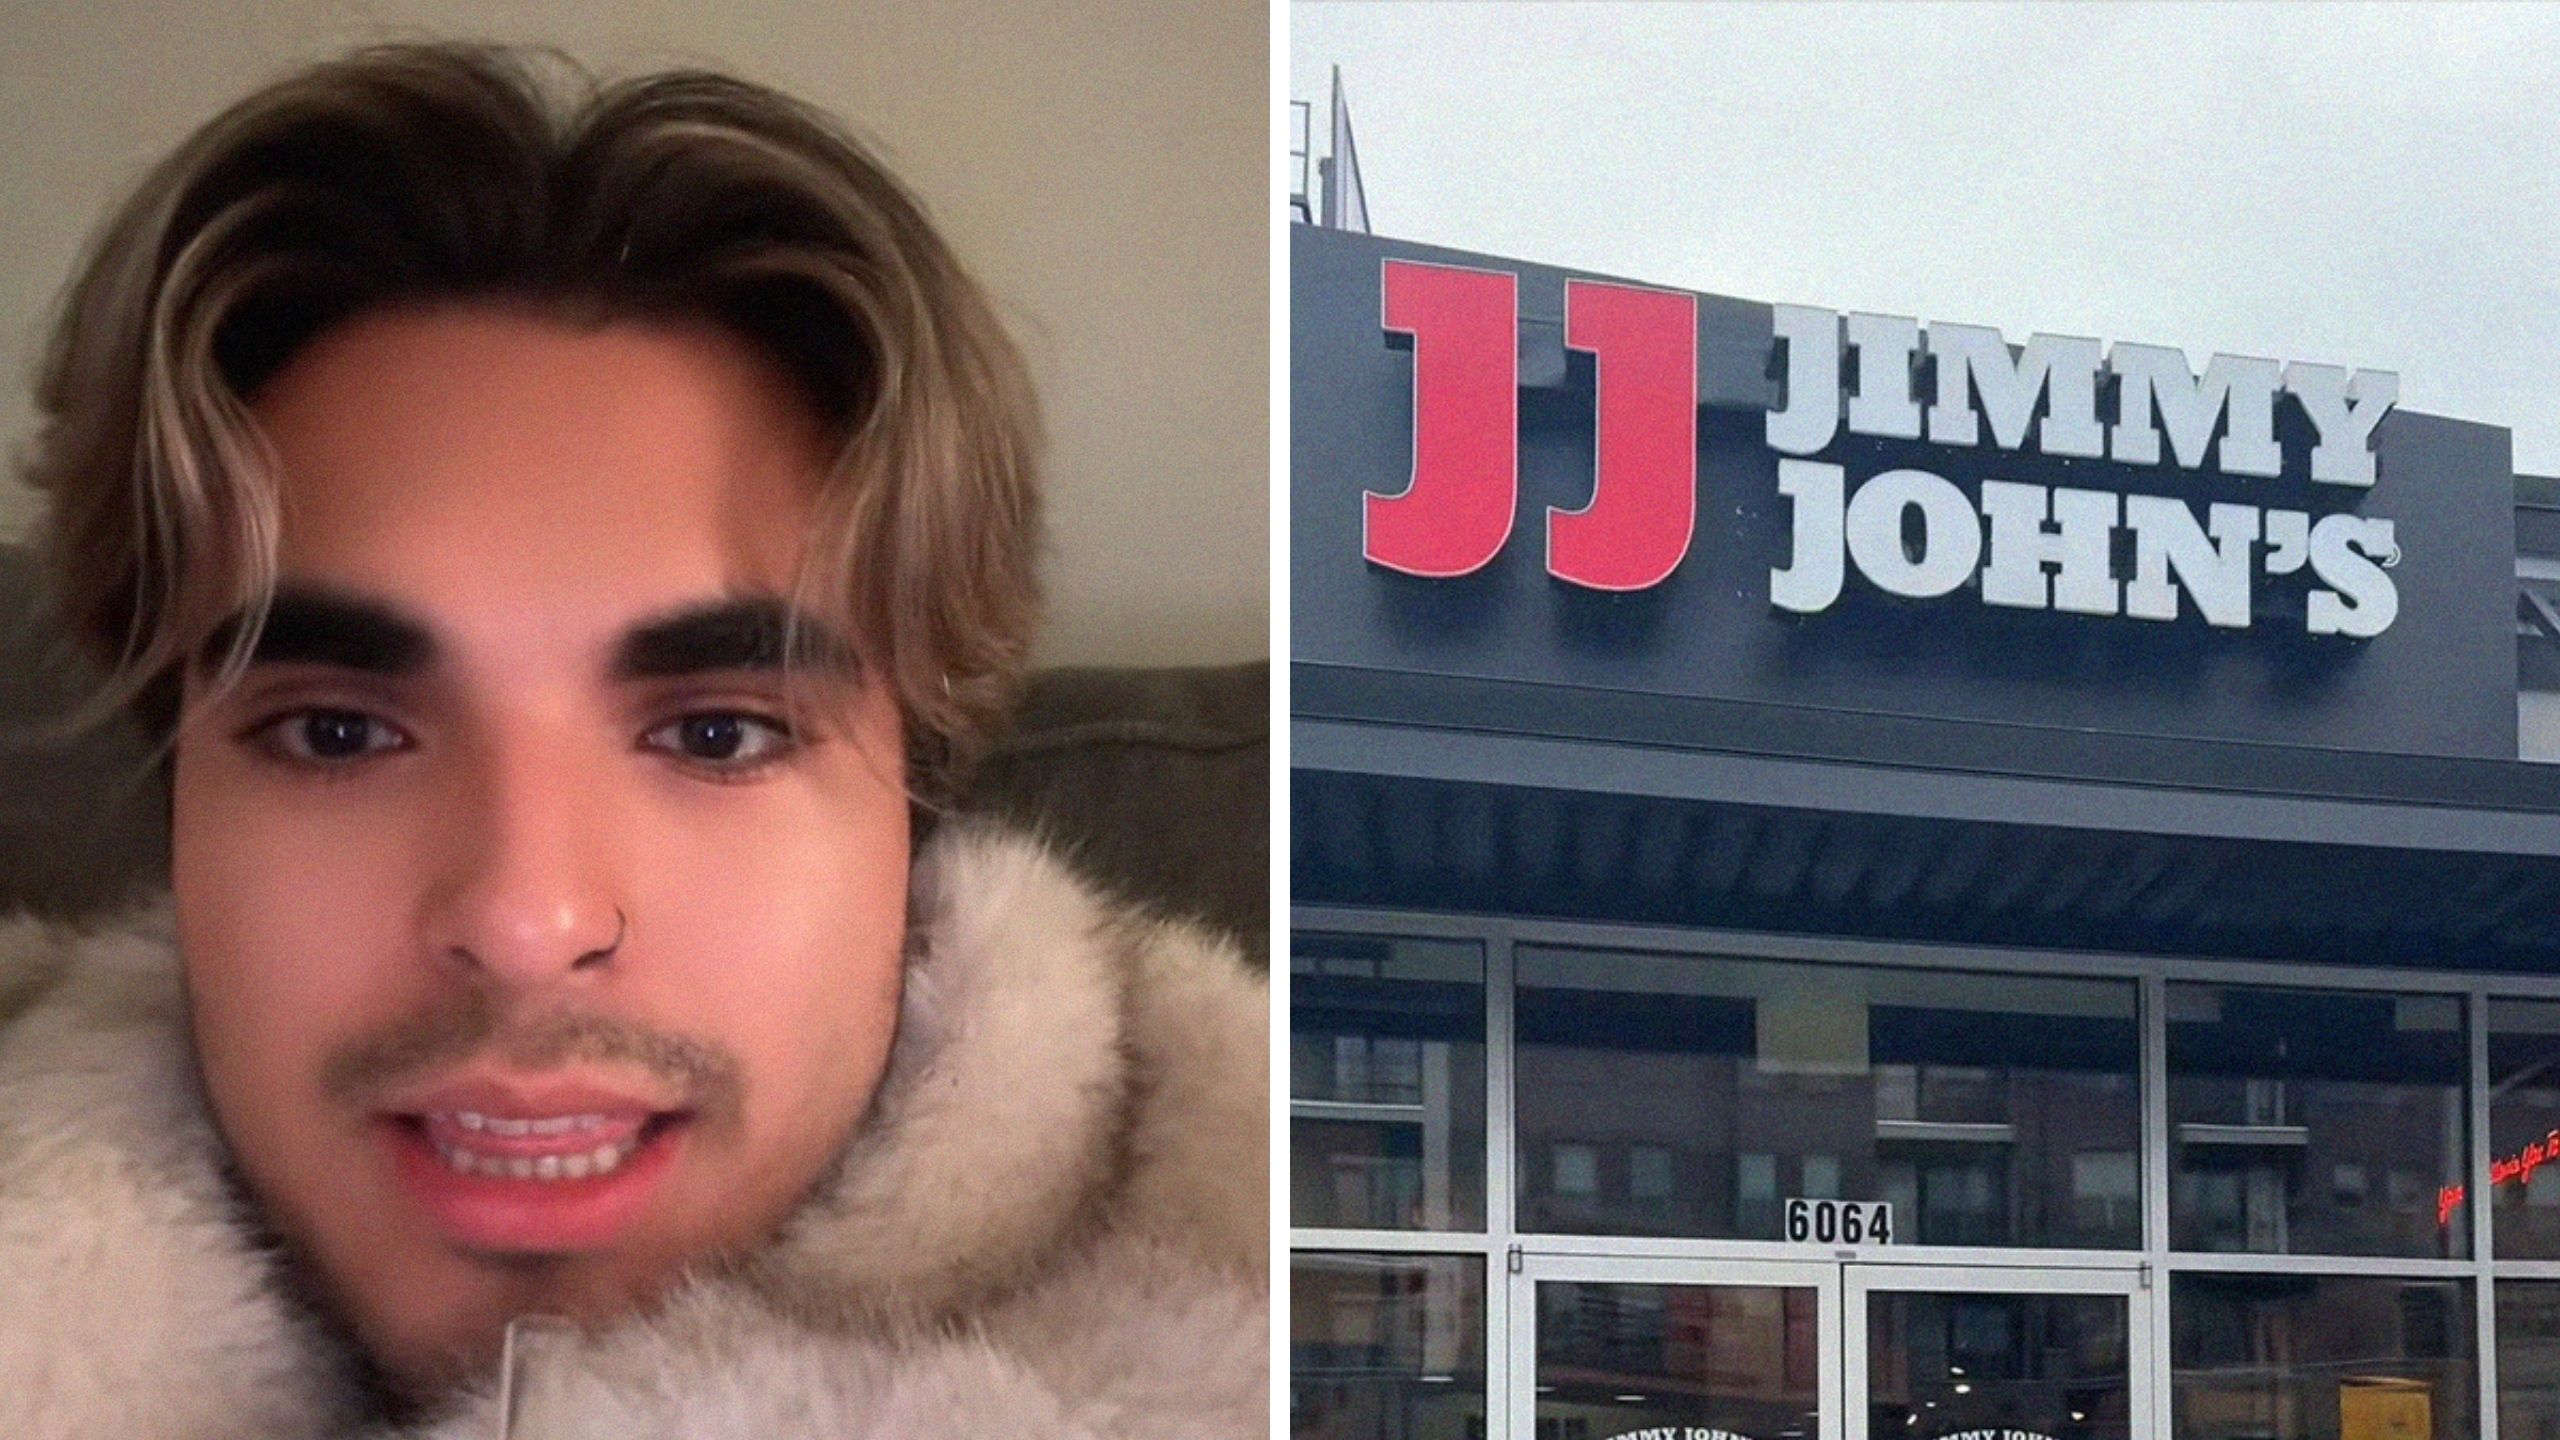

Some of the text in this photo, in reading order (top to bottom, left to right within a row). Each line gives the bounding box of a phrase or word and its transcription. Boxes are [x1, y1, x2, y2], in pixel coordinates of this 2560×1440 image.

[1363, 258, 1698, 592] JJ
[1766, 303, 2399, 486] JIMMY
[1770, 458, 2399, 637] JOHN'S
[1789, 1200, 1890, 1245] 6064
